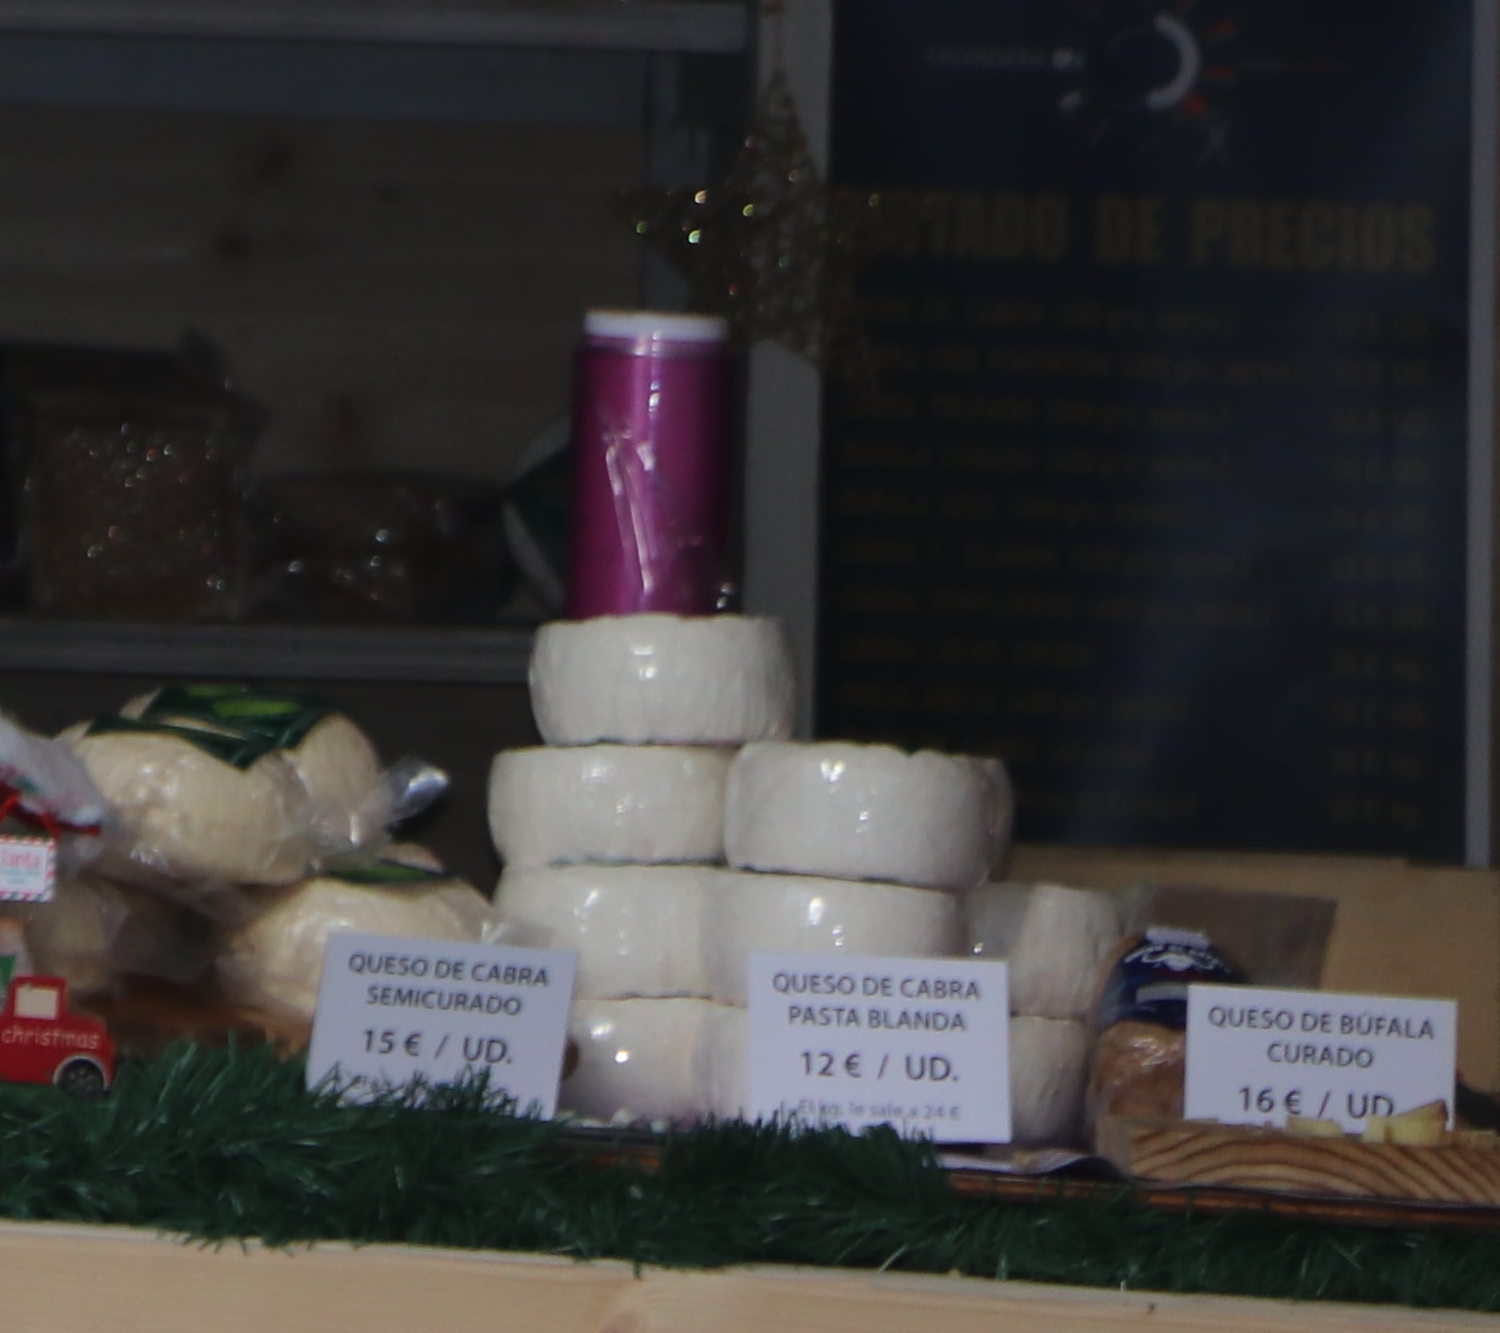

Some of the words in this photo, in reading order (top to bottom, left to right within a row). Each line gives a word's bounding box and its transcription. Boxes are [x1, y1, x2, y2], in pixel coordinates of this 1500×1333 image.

[1189, 198, 1437, 275] PRECIOS
[347, 950, 429, 977] QUESO
[434, 958, 463, 982] DE
[470, 961, 550, 988] CABRA
[772, 971, 855, 997] QUESO
[862, 976, 893, 998] DE
[899, 977, 980, 1000] CABRA
[366, 985, 523, 1016] SEMICURADO
[787, 1004, 860, 1028] PASTA
[867, 1009, 967, 1031] BLANDA
[1208, 1005, 1294, 1031] QUESO
[1300, 1012, 1333, 1034] DE
[1340, 1008, 1436, 1040] BÚFALA
[1, 1023, 101, 1050] christmas
[462, 1036, 514, 1065] UD.
[904, 1054, 960, 1083] UD.
[1266, 1041, 1375, 1069] CURADO
[870, 1101, 904, 1117] sale
